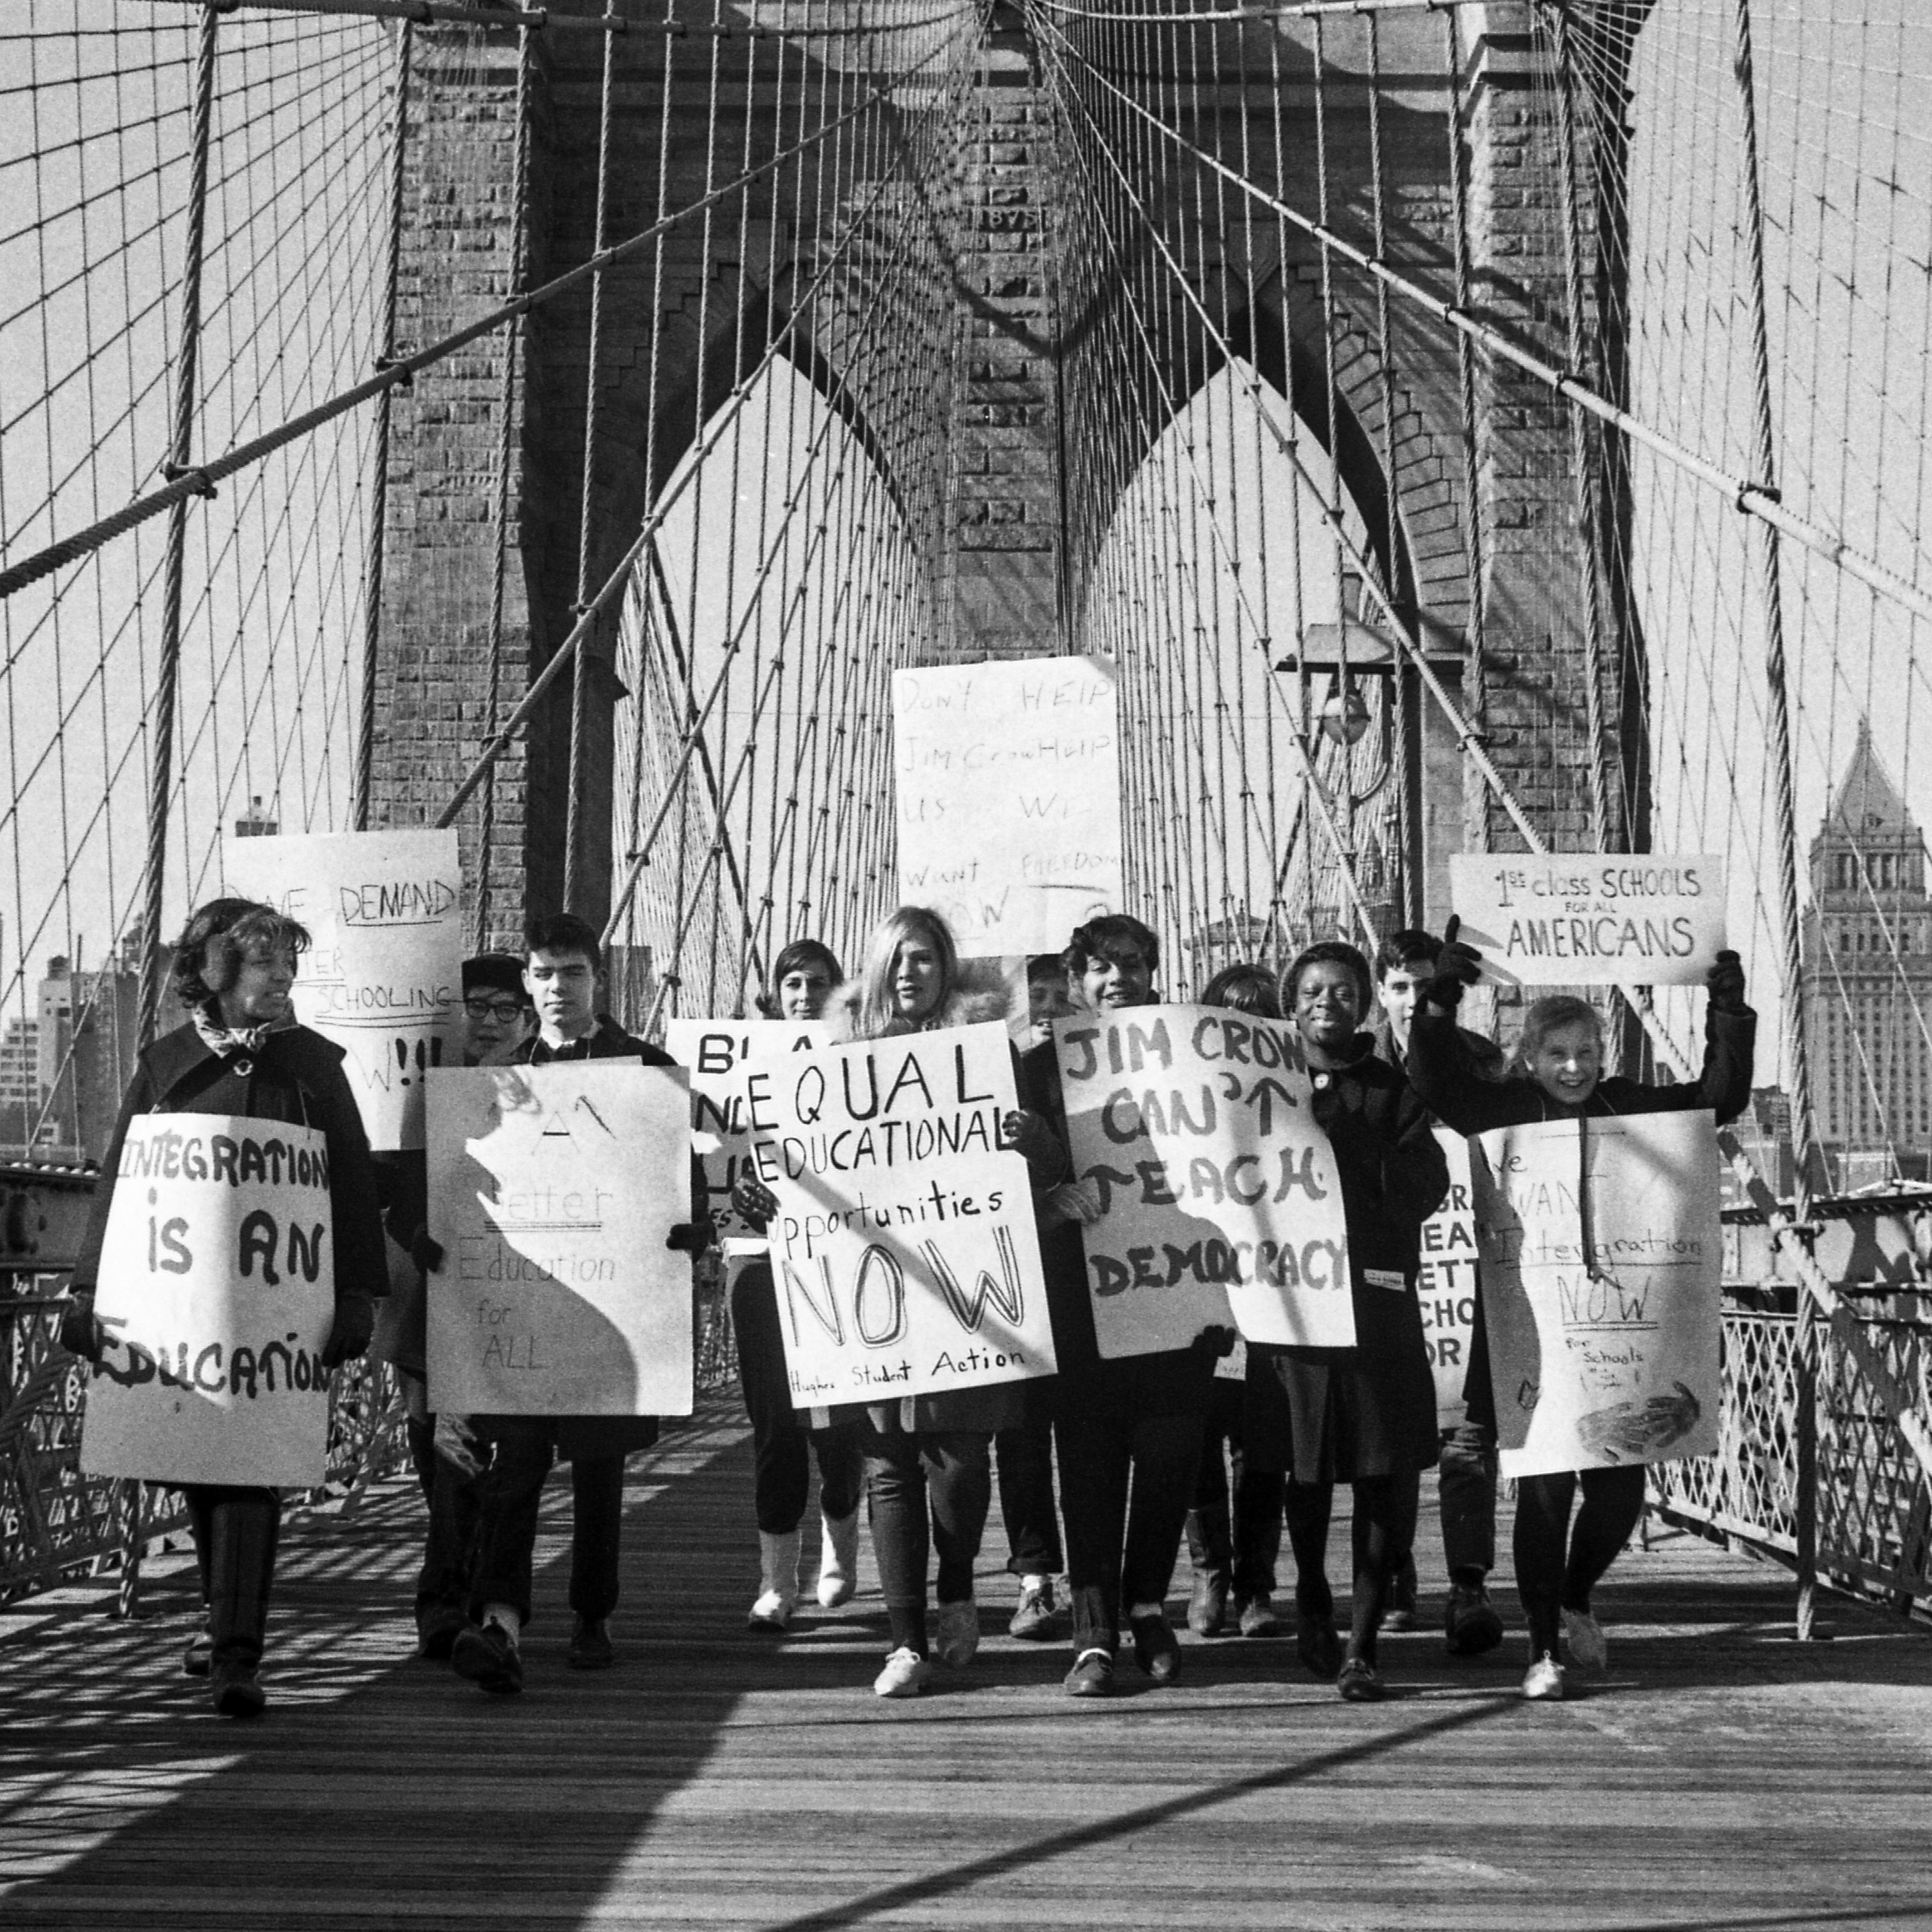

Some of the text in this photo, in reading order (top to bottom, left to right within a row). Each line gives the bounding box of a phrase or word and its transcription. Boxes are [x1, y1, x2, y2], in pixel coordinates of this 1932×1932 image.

[340, 880, 454, 922] DEMAND
[1532, 868, 1591, 897] class
[1601, 868, 1702, 899] SCHOOLS
[949, 885, 1010, 929] OW
[1565, 901, 1618, 913] FOR ALL
[1507, 916, 1695, 957] AMERICANS
[316, 984, 450, 1015] SCHOOLING
[1064, 1016, 1307, 1081] JIM CROW
[747, 1043, 994, 1133] EQUAL
[1101, 1072, 1298, 1144] CAN'T
[117, 1128, 329, 1190] INTEGRATION
[755, 1106, 1009, 1182] EDUCATIONAL
[238, 1209, 326, 1286] AN
[458, 1236, 615, 1281] Education
[1088, 1234, 1348, 1298] DEMOCRACY
[783, 1225, 1024, 1348] NOW
[1558, 1274, 1651, 1321] NOW
[478, 1298, 512, 1326] for
[481, 1334, 551, 1370] ALL
[850, 1358, 912, 1387] Student
[931, 1346, 1025, 1377] Action
